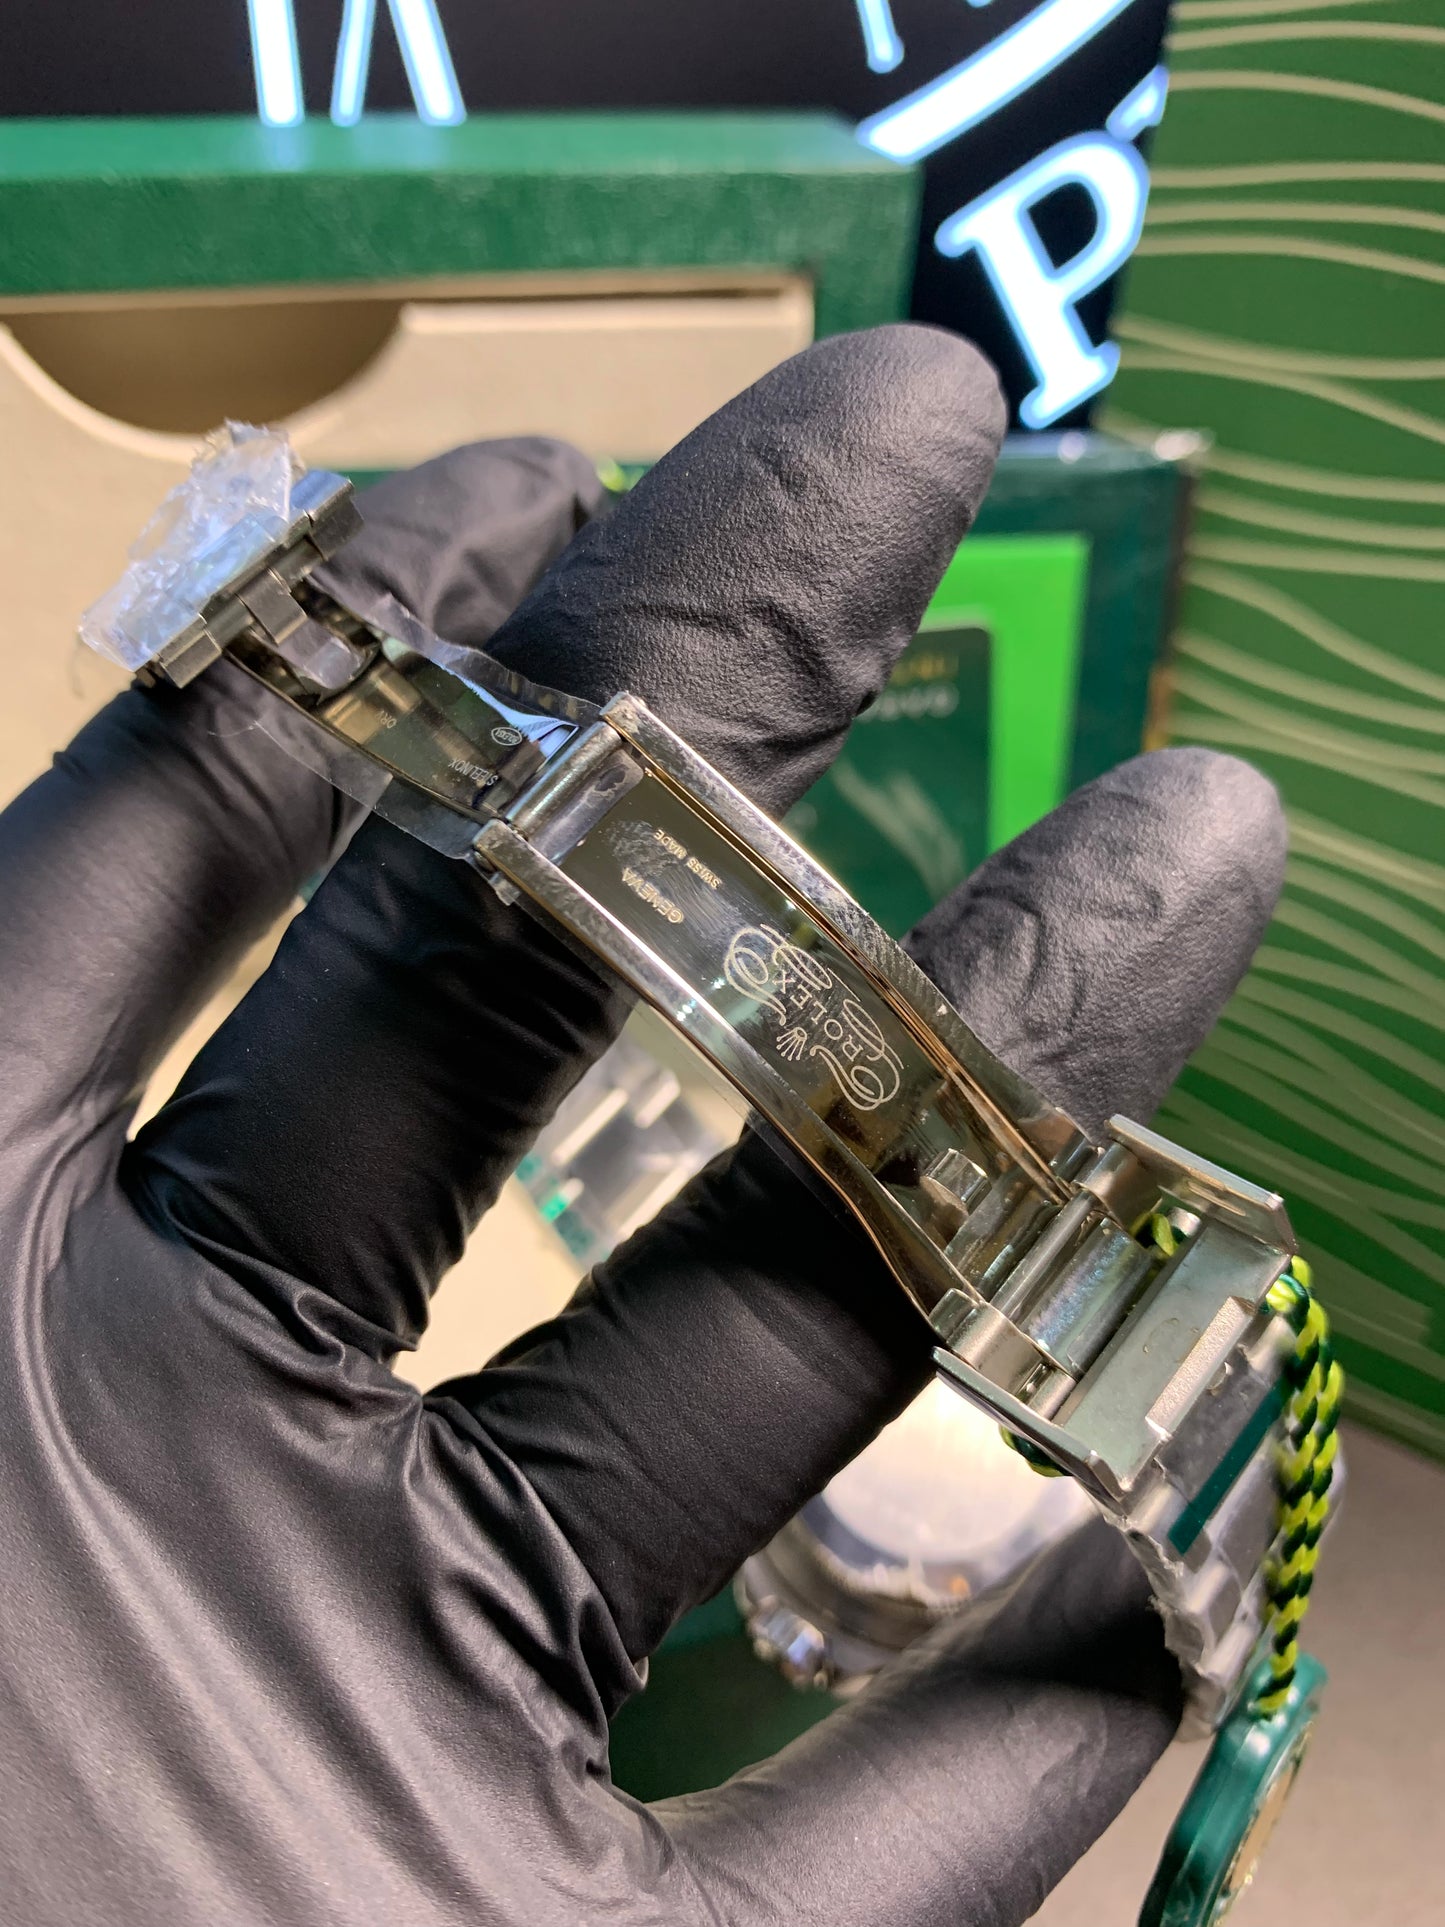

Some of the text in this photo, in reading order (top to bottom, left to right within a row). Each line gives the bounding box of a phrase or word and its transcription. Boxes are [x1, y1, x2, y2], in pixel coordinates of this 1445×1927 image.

[653, 829, 722, 889] SWISS MADE
[621, 867, 684, 924] GENEVA
[772, 970, 863, 1061] ROLEX
